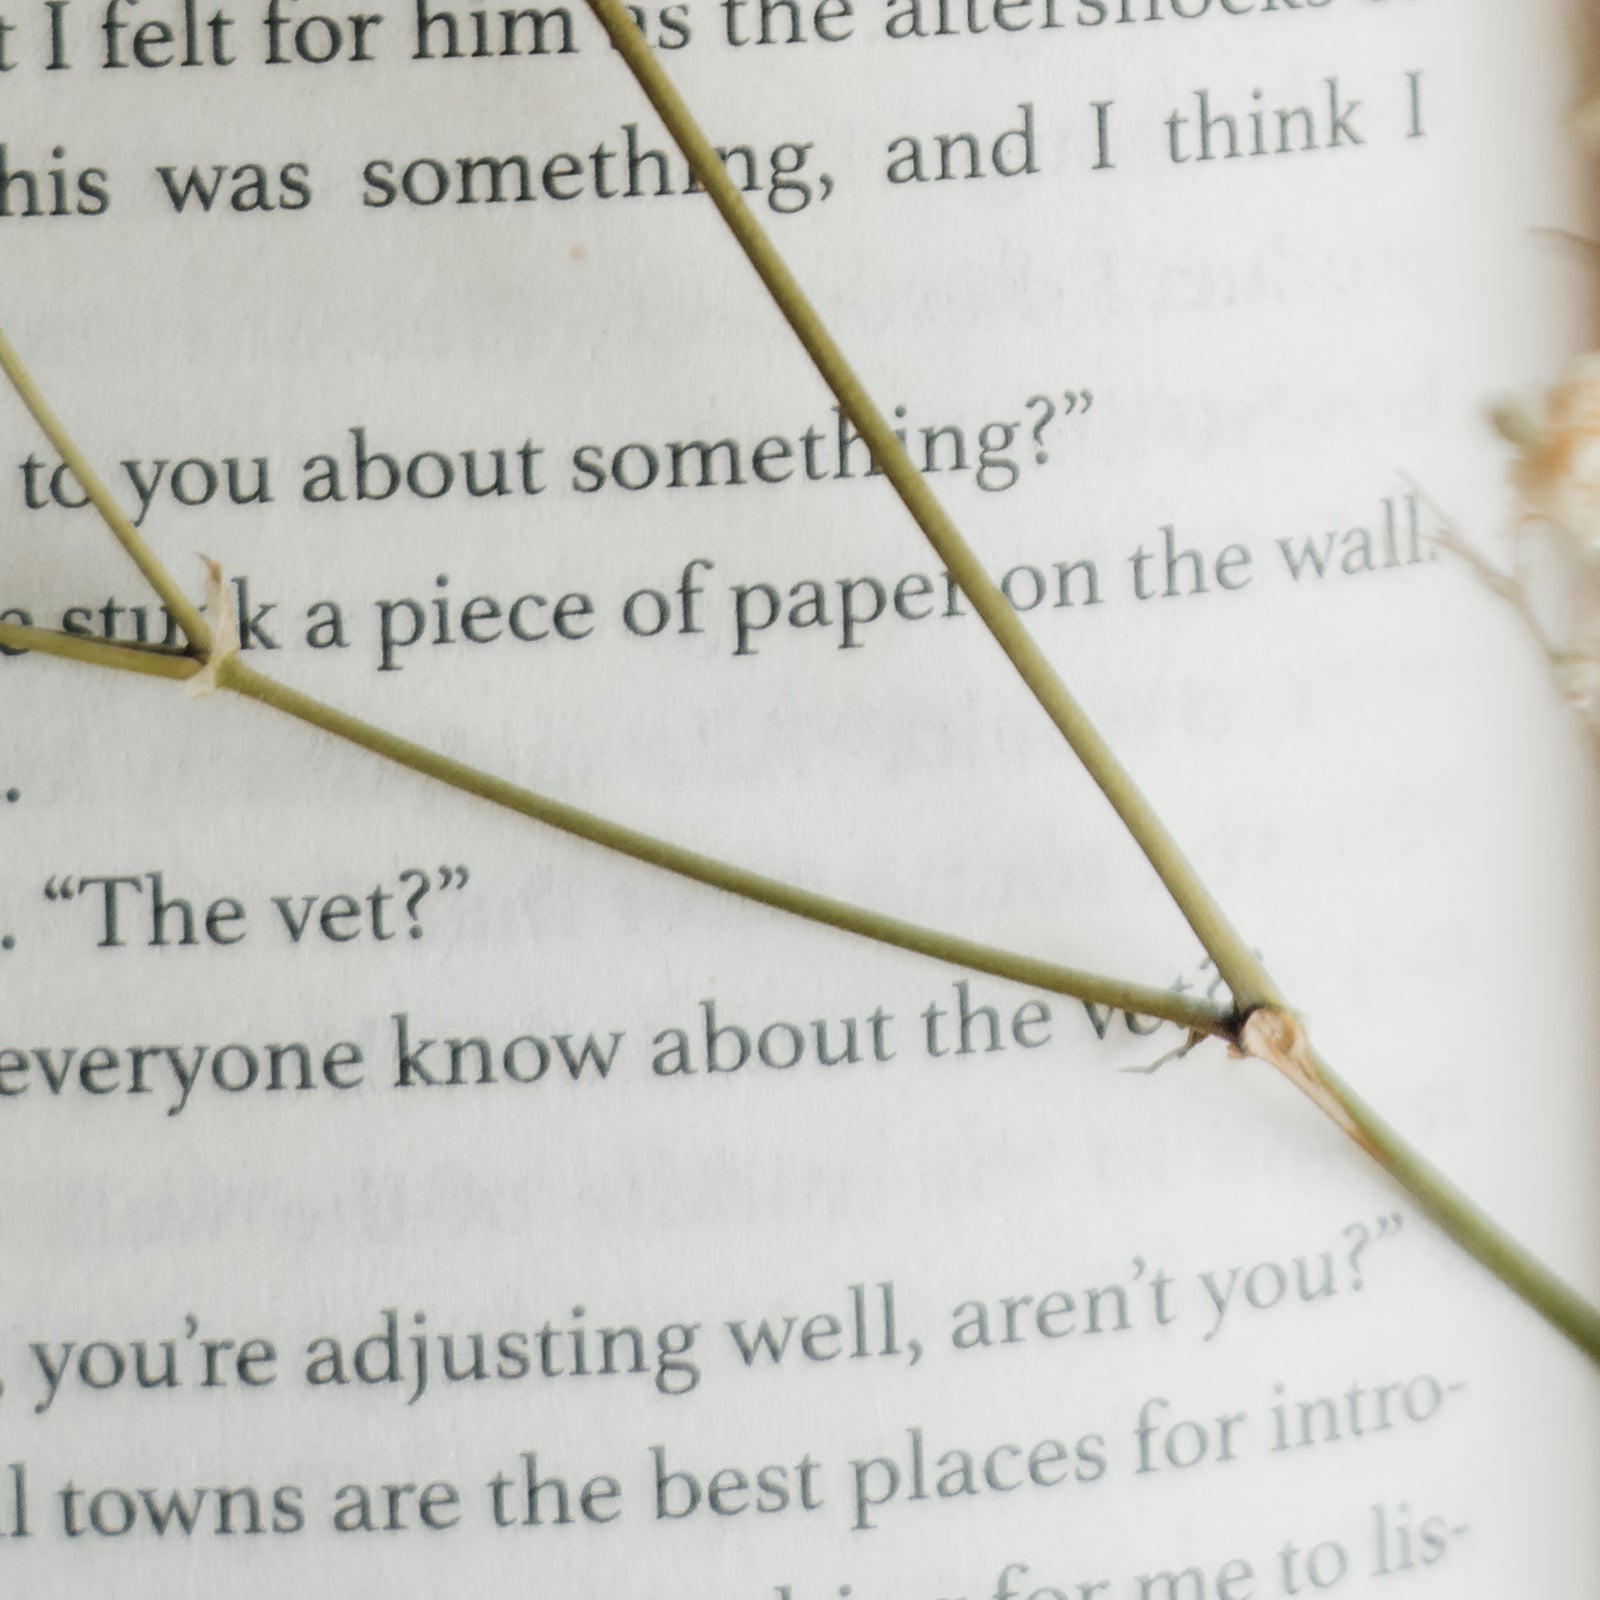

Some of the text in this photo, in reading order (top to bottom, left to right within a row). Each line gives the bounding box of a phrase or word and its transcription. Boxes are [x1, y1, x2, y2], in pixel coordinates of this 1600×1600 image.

[44, 0, 73, 71] I
[155, 156, 314, 215] was
[361, 122, 836, 216] something,
[885, 101, 1043, 187] and
[1089, 100, 1117, 172] I
[1163, 74, 1368, 166] think
[1402, 69, 1429, 140] I
[119, 451, 277, 528] you
[301, 425, 549, 503] about
[570, 388, 1096, 495] something?”
[303, 601, 351, 650] a
[376, 572, 596, 672] piece
[621, 557, 716, 640] of
[998, 553, 1104, 614] on
[1128, 522, 1254, 601] the
[43, 862, 470, 950] “The vet?”
[0, 1035, 366, 1119] everyone
[390, 1010, 627, 1090] know
[650, 997, 898, 1080] about
[920, 978, 1055, 1062] the
[28, 1210, 1406, 1417] you’re adjusting well, aren’t you?”
[57, 1477, 307, 1542] towns
[332, 1476, 464, 1539] are
[486, 1447, 625, 1528] the
[647, 1442, 823, 1522] best
[849, 1425, 1110, 1533] places
[1131, 1396, 1249, 1479] for
[1269, 1369, 1470, 1458] intro-
[1275, 1536, 1350, 1599] to
[1368, 1498, 1475, 1580] lis-
